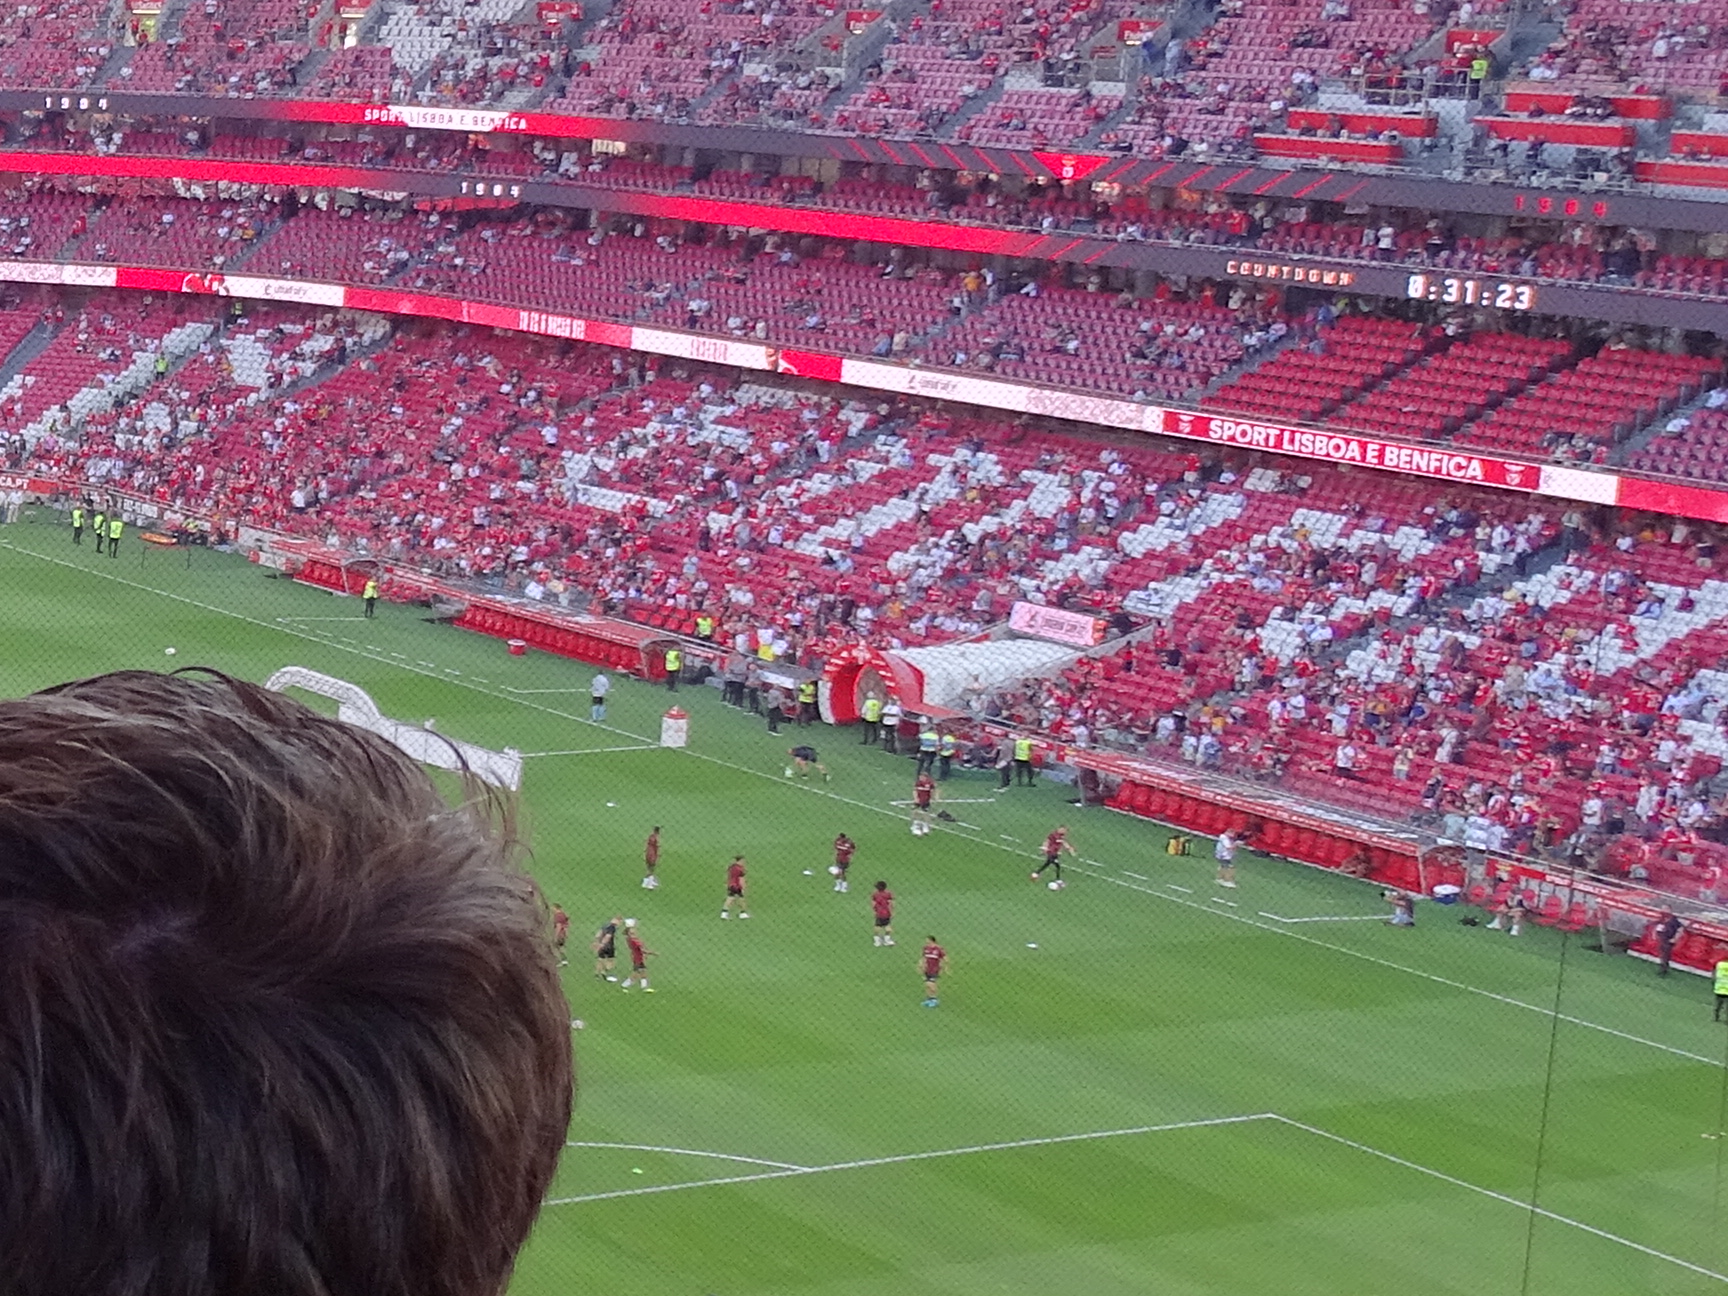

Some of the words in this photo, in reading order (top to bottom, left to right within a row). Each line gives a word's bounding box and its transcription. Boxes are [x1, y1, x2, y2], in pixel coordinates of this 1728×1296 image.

[408, 111, 453, 124] LISBOA
[1225, 260, 1355, 286] COUNTDOWN
[1406, 274, 1536, 310] 0:31:23
[1208, 418, 1281, 448] SPORT
[1282, 429, 1363, 462] LISBOA
[1365, 443, 1380, 465] E
[1384, 445, 1485, 481] BENFICA
